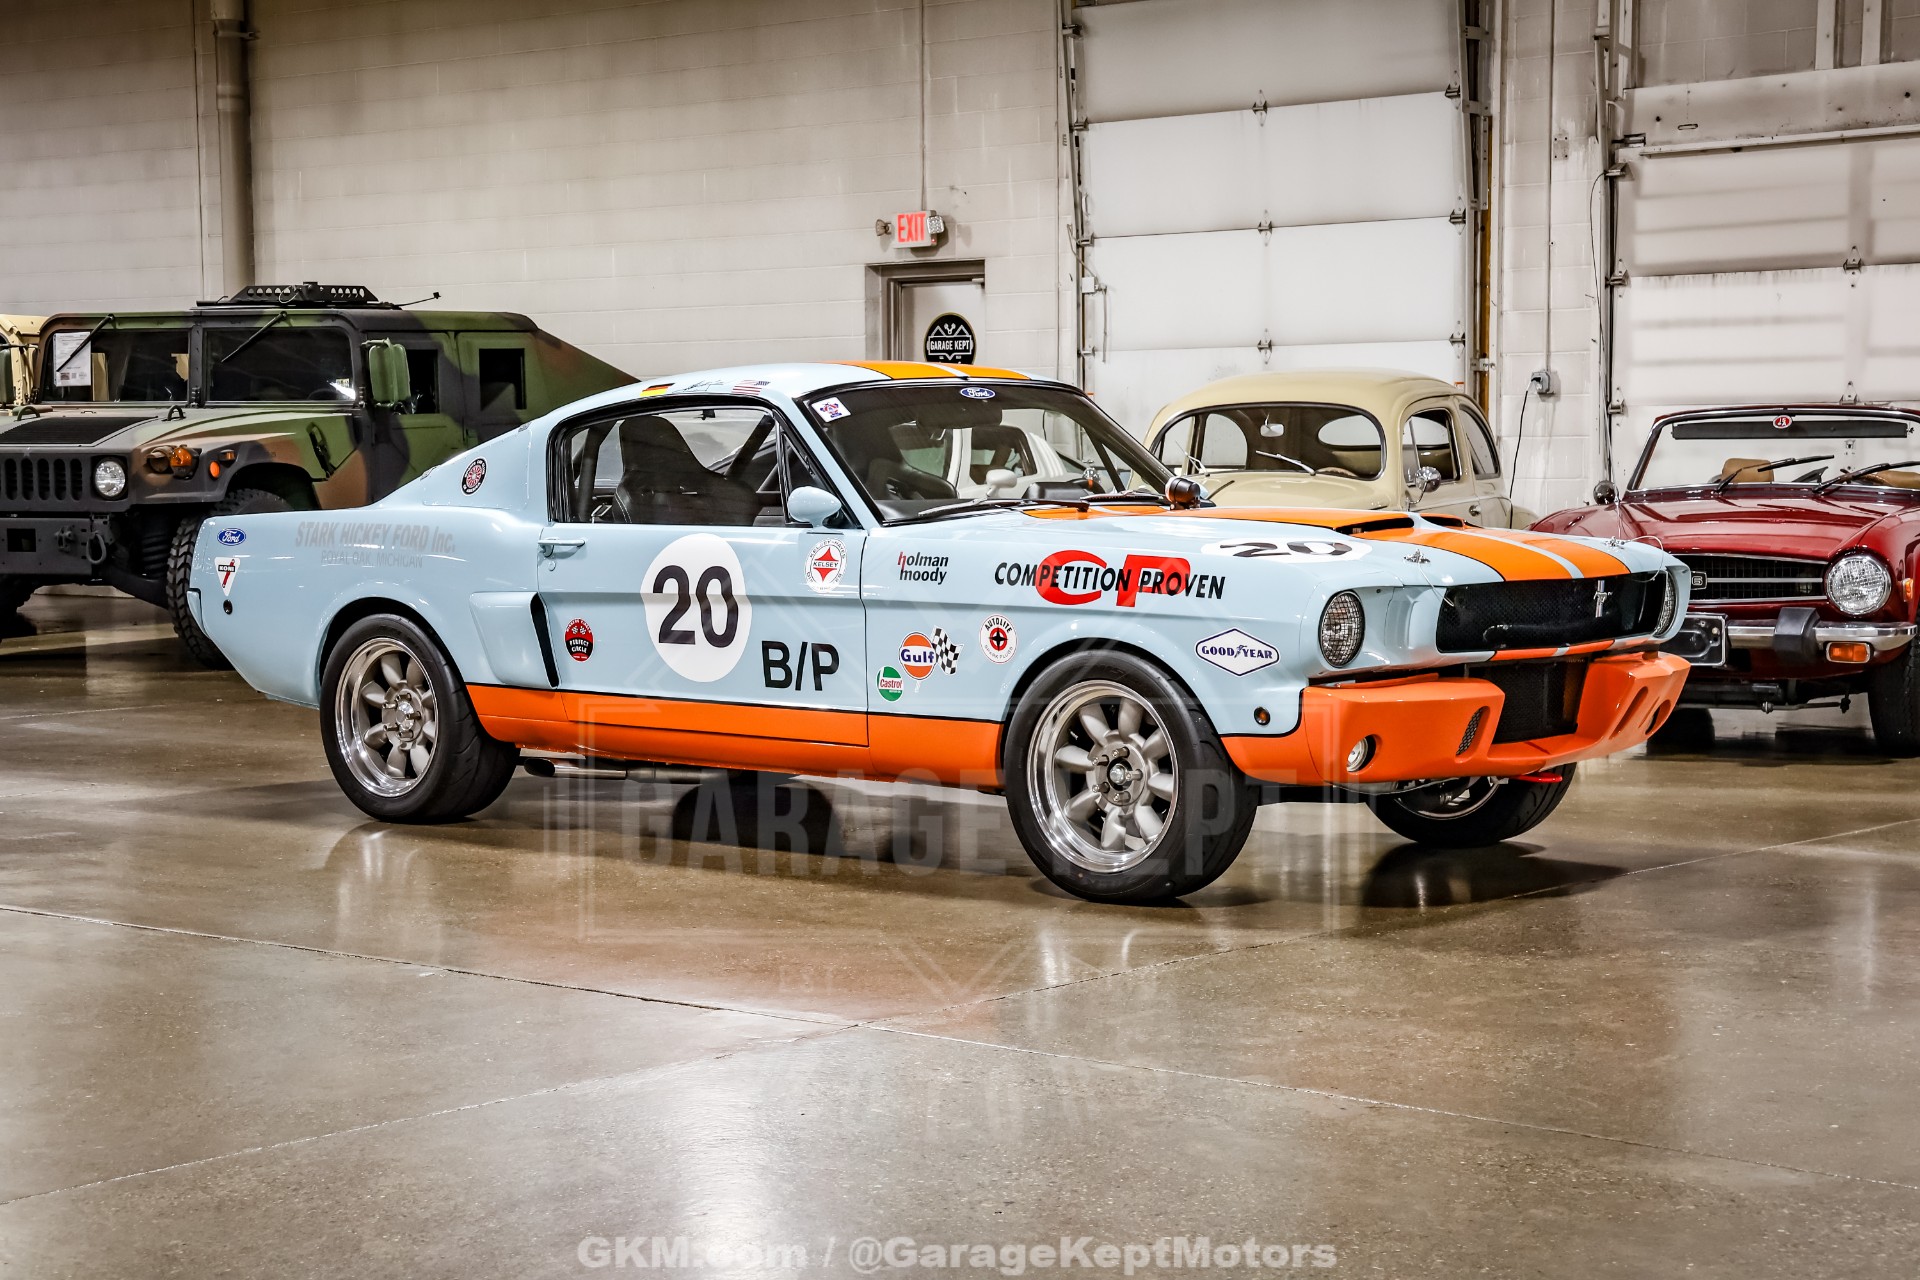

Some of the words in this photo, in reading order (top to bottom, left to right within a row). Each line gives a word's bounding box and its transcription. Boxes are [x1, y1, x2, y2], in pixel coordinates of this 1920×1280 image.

[897, 212, 926, 243] EXIT
[930, 340, 953, 350] GARAGE
[954, 340, 969, 350] KEPT
[965, 387, 992, 398] Ford
[222, 530, 242, 543] Ford
[295, 521, 339, 547] STARK
[340, 523, 390, 550] HICKEY
[392, 525, 431, 550] FORD
[431, 527, 456, 553] Inc.
[1219, 541, 1353, 557] 20
[321, 550, 349, 564] ROYAL
[377, 553, 424, 568] MICHIGAN
[898, 552, 949, 573] holman
[900, 567, 948, 586] moody
[994, 562, 1132, 593] COMPETITION
[1138, 569, 1227, 601] PROVEN
[652, 564, 740, 648] 20
[984, 617, 1013, 634] AUTOLITE
[569, 638, 589, 648] PERFECT
[900, 648, 935, 664] Gulf
[761, 640, 840, 692] B/P
[879, 678, 903, 689] Castrol
